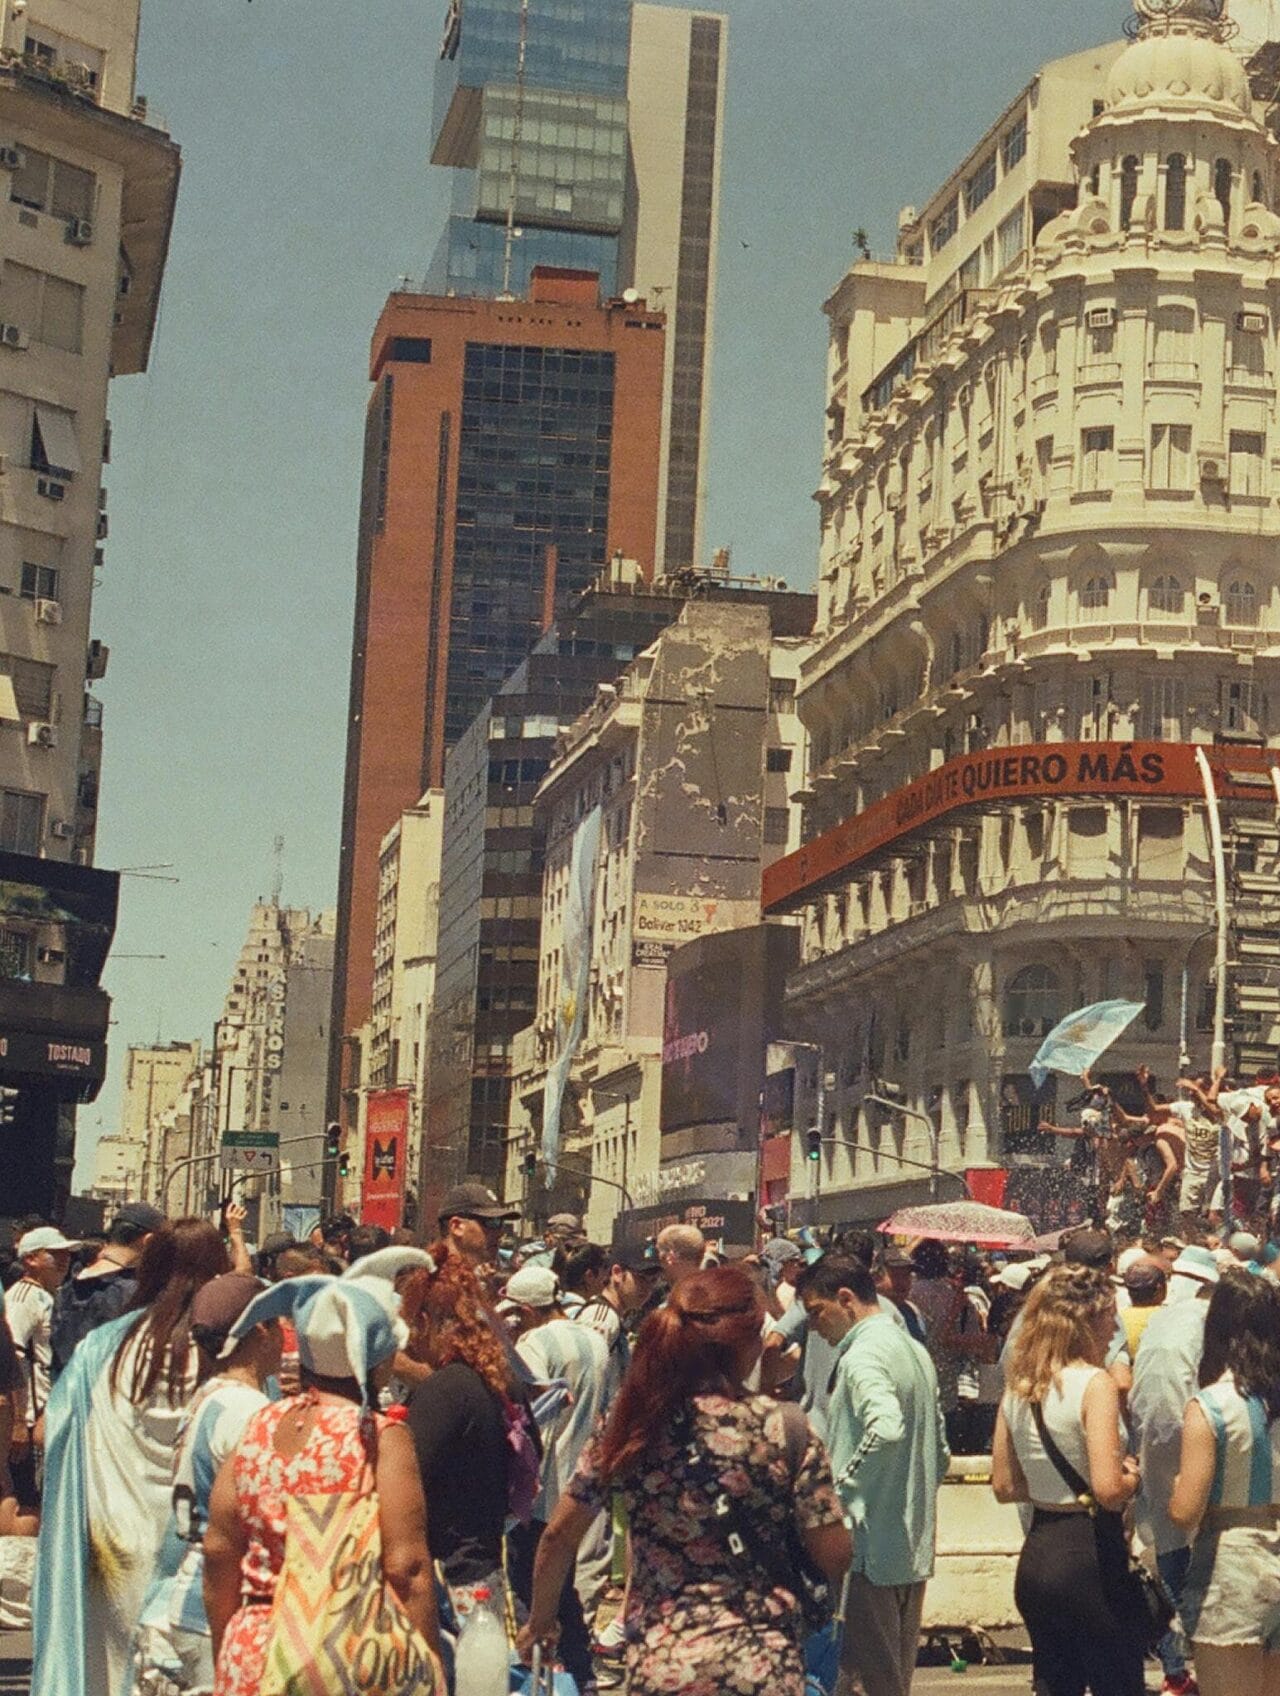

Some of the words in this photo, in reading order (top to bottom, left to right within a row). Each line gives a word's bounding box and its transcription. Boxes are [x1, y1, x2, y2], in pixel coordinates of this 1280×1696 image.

[945, 767, 959, 800] TE
[962, 752, 1068, 797] QUIERO
[1077, 743, 1165, 785] MÁS
[267, 967, 287, 1070] ASTROS
[48, 1043, 92, 1066] TOSTADO
